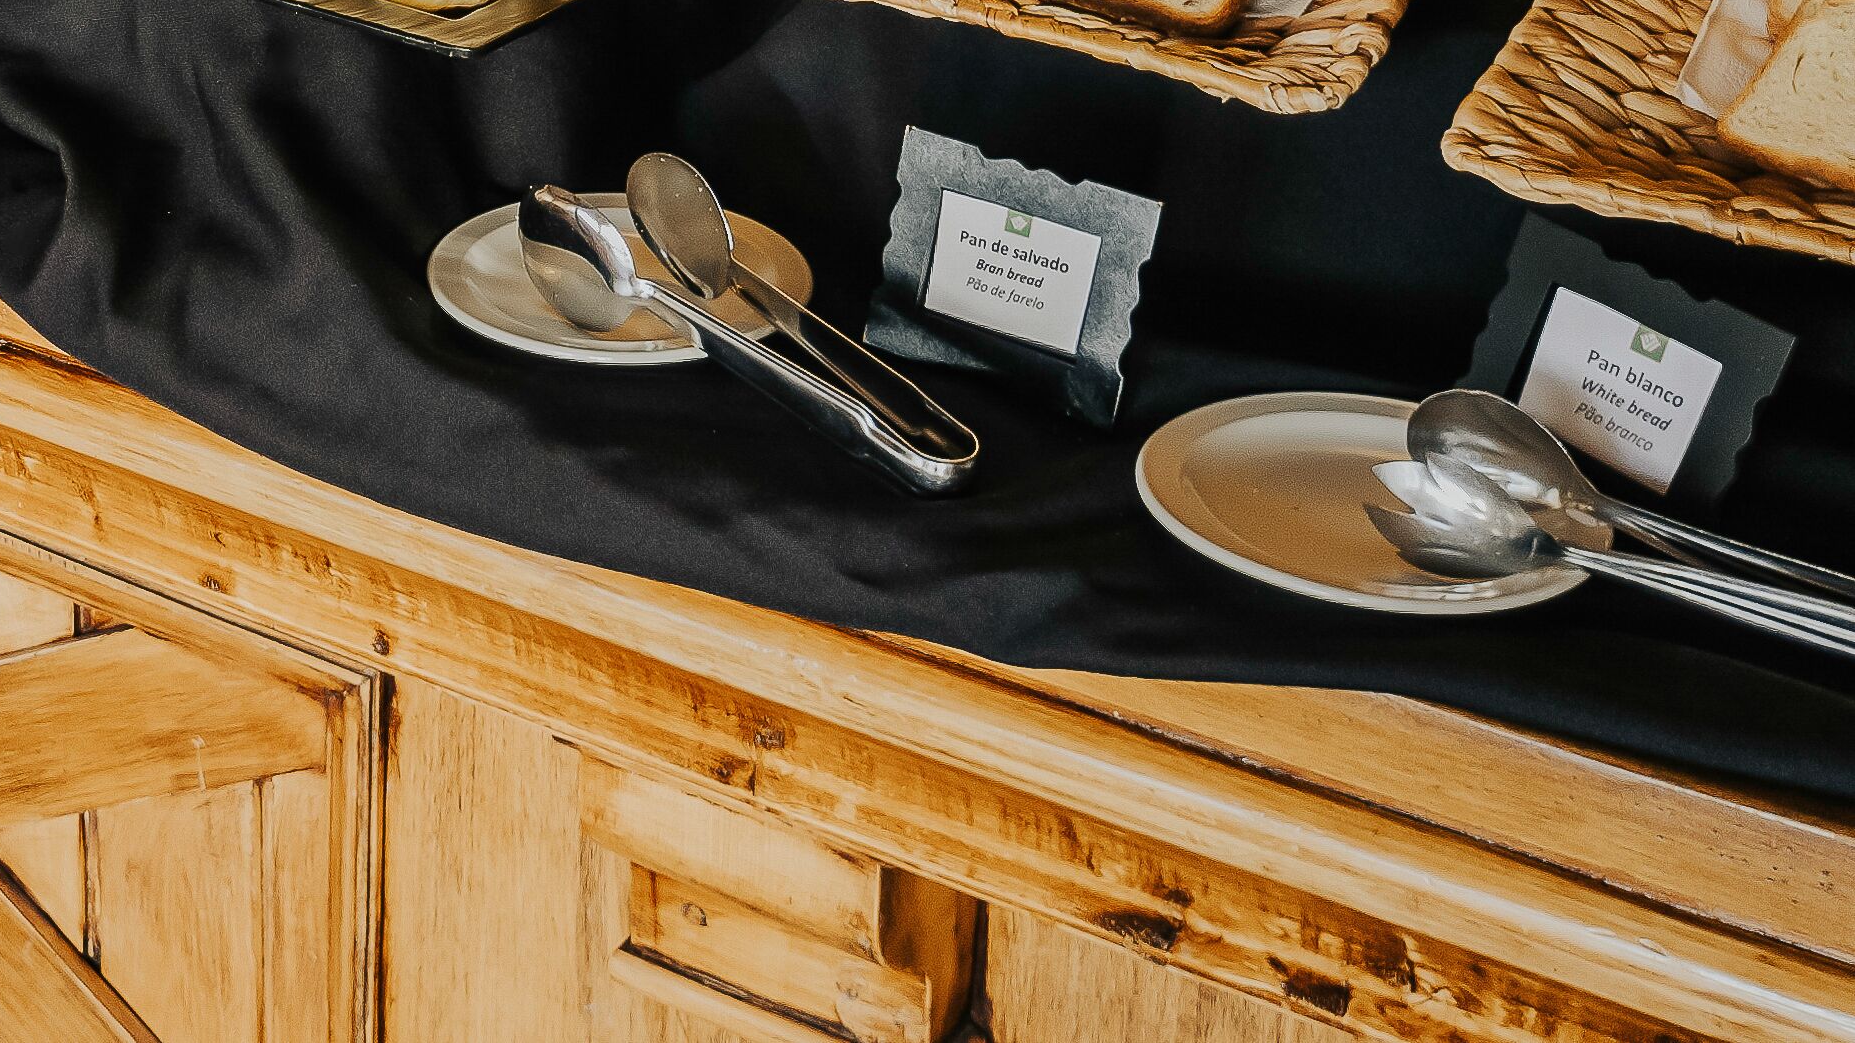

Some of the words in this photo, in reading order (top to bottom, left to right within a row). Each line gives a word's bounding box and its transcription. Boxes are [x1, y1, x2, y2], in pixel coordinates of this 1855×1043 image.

[959, 230, 987, 250] Pan
[991, 239, 1009, 256] de
[1011, 249, 1070, 274] salvado
[975, 258, 1004, 277] Bran
[1006, 267, 1045, 289] bread
[966, 276, 988, 293] Pão
[990, 284, 1006, 299] de
[1005, 288, 1045, 310] farelo
[1586, 349, 1621, 377] Pan
[1625, 366, 1684, 408] blanco
[1574, 402, 1603, 426] Pão
[1605, 417, 1654, 452] branco
[1581, 376, 1625, 408] White
[1626, 399, 1673, 432] bread
